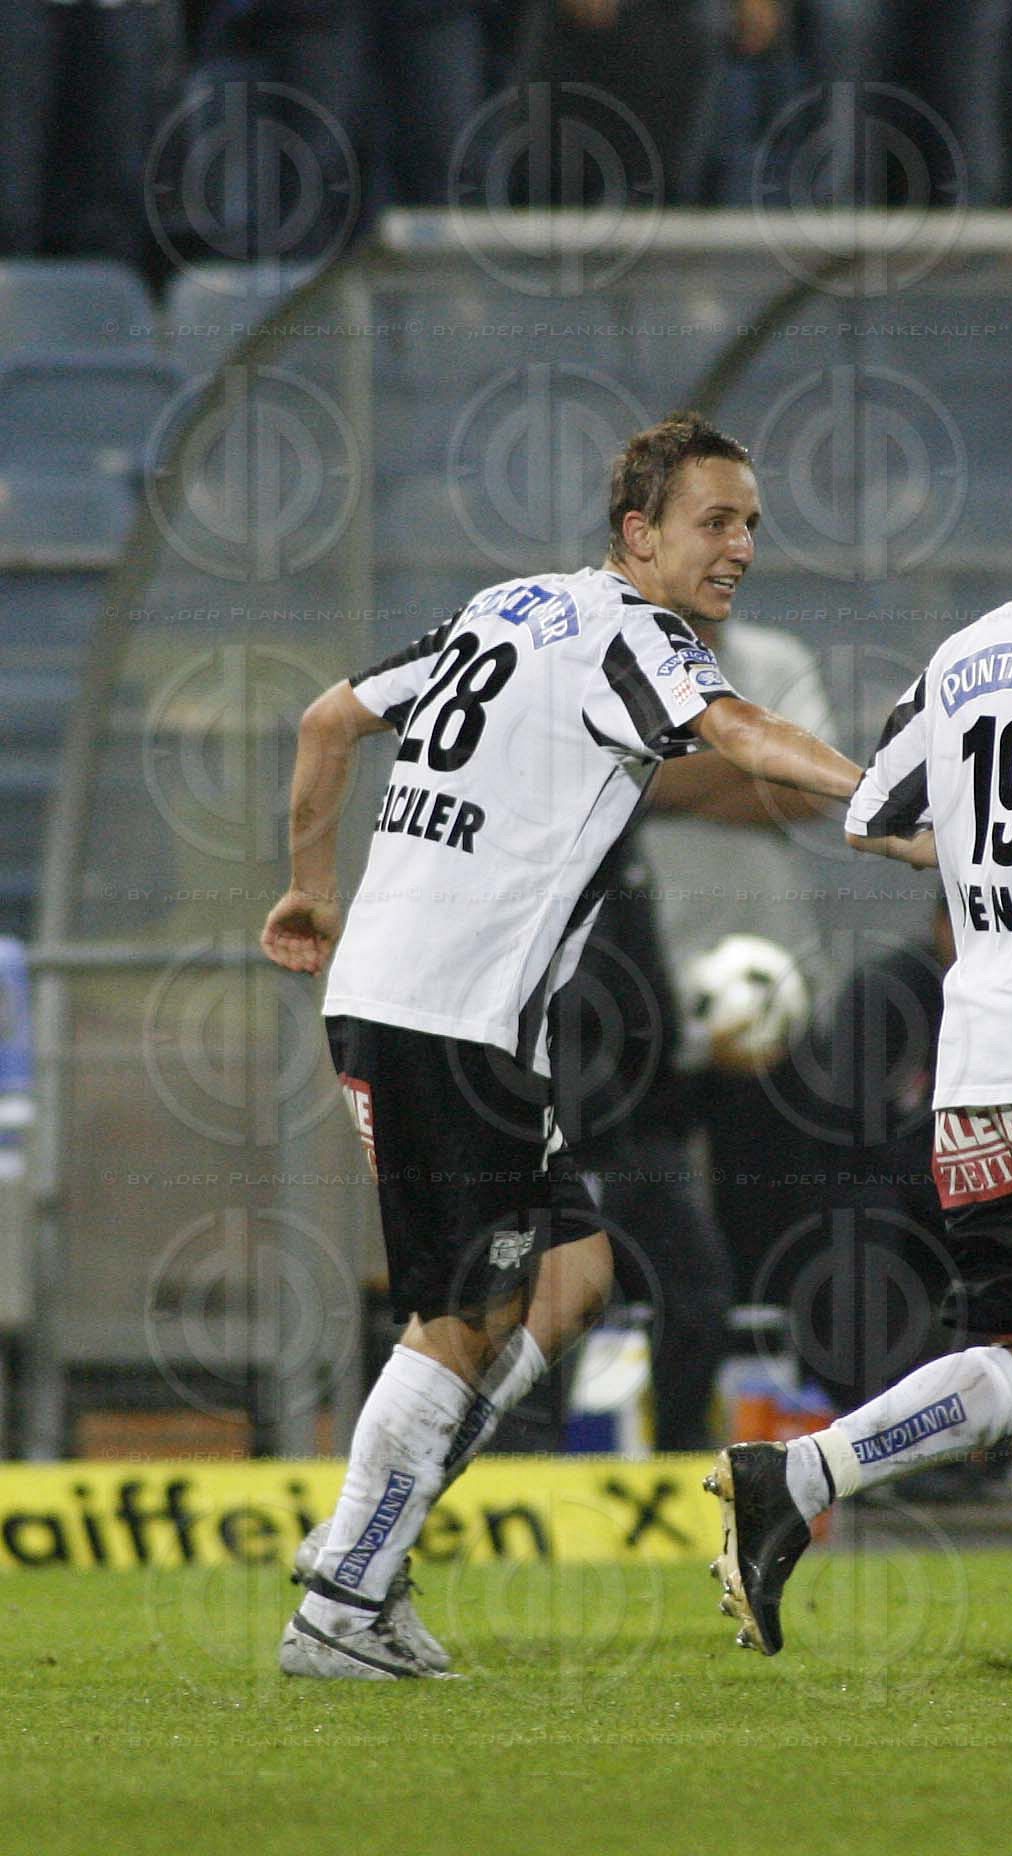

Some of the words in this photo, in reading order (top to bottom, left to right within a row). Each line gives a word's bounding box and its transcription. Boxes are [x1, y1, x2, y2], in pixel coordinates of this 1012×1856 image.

[394, 631, 518, 773] 28
[853, 1398, 963, 1461] PUNTIGAME
[336, 1472, 413, 1588] PUNTIGAMER
